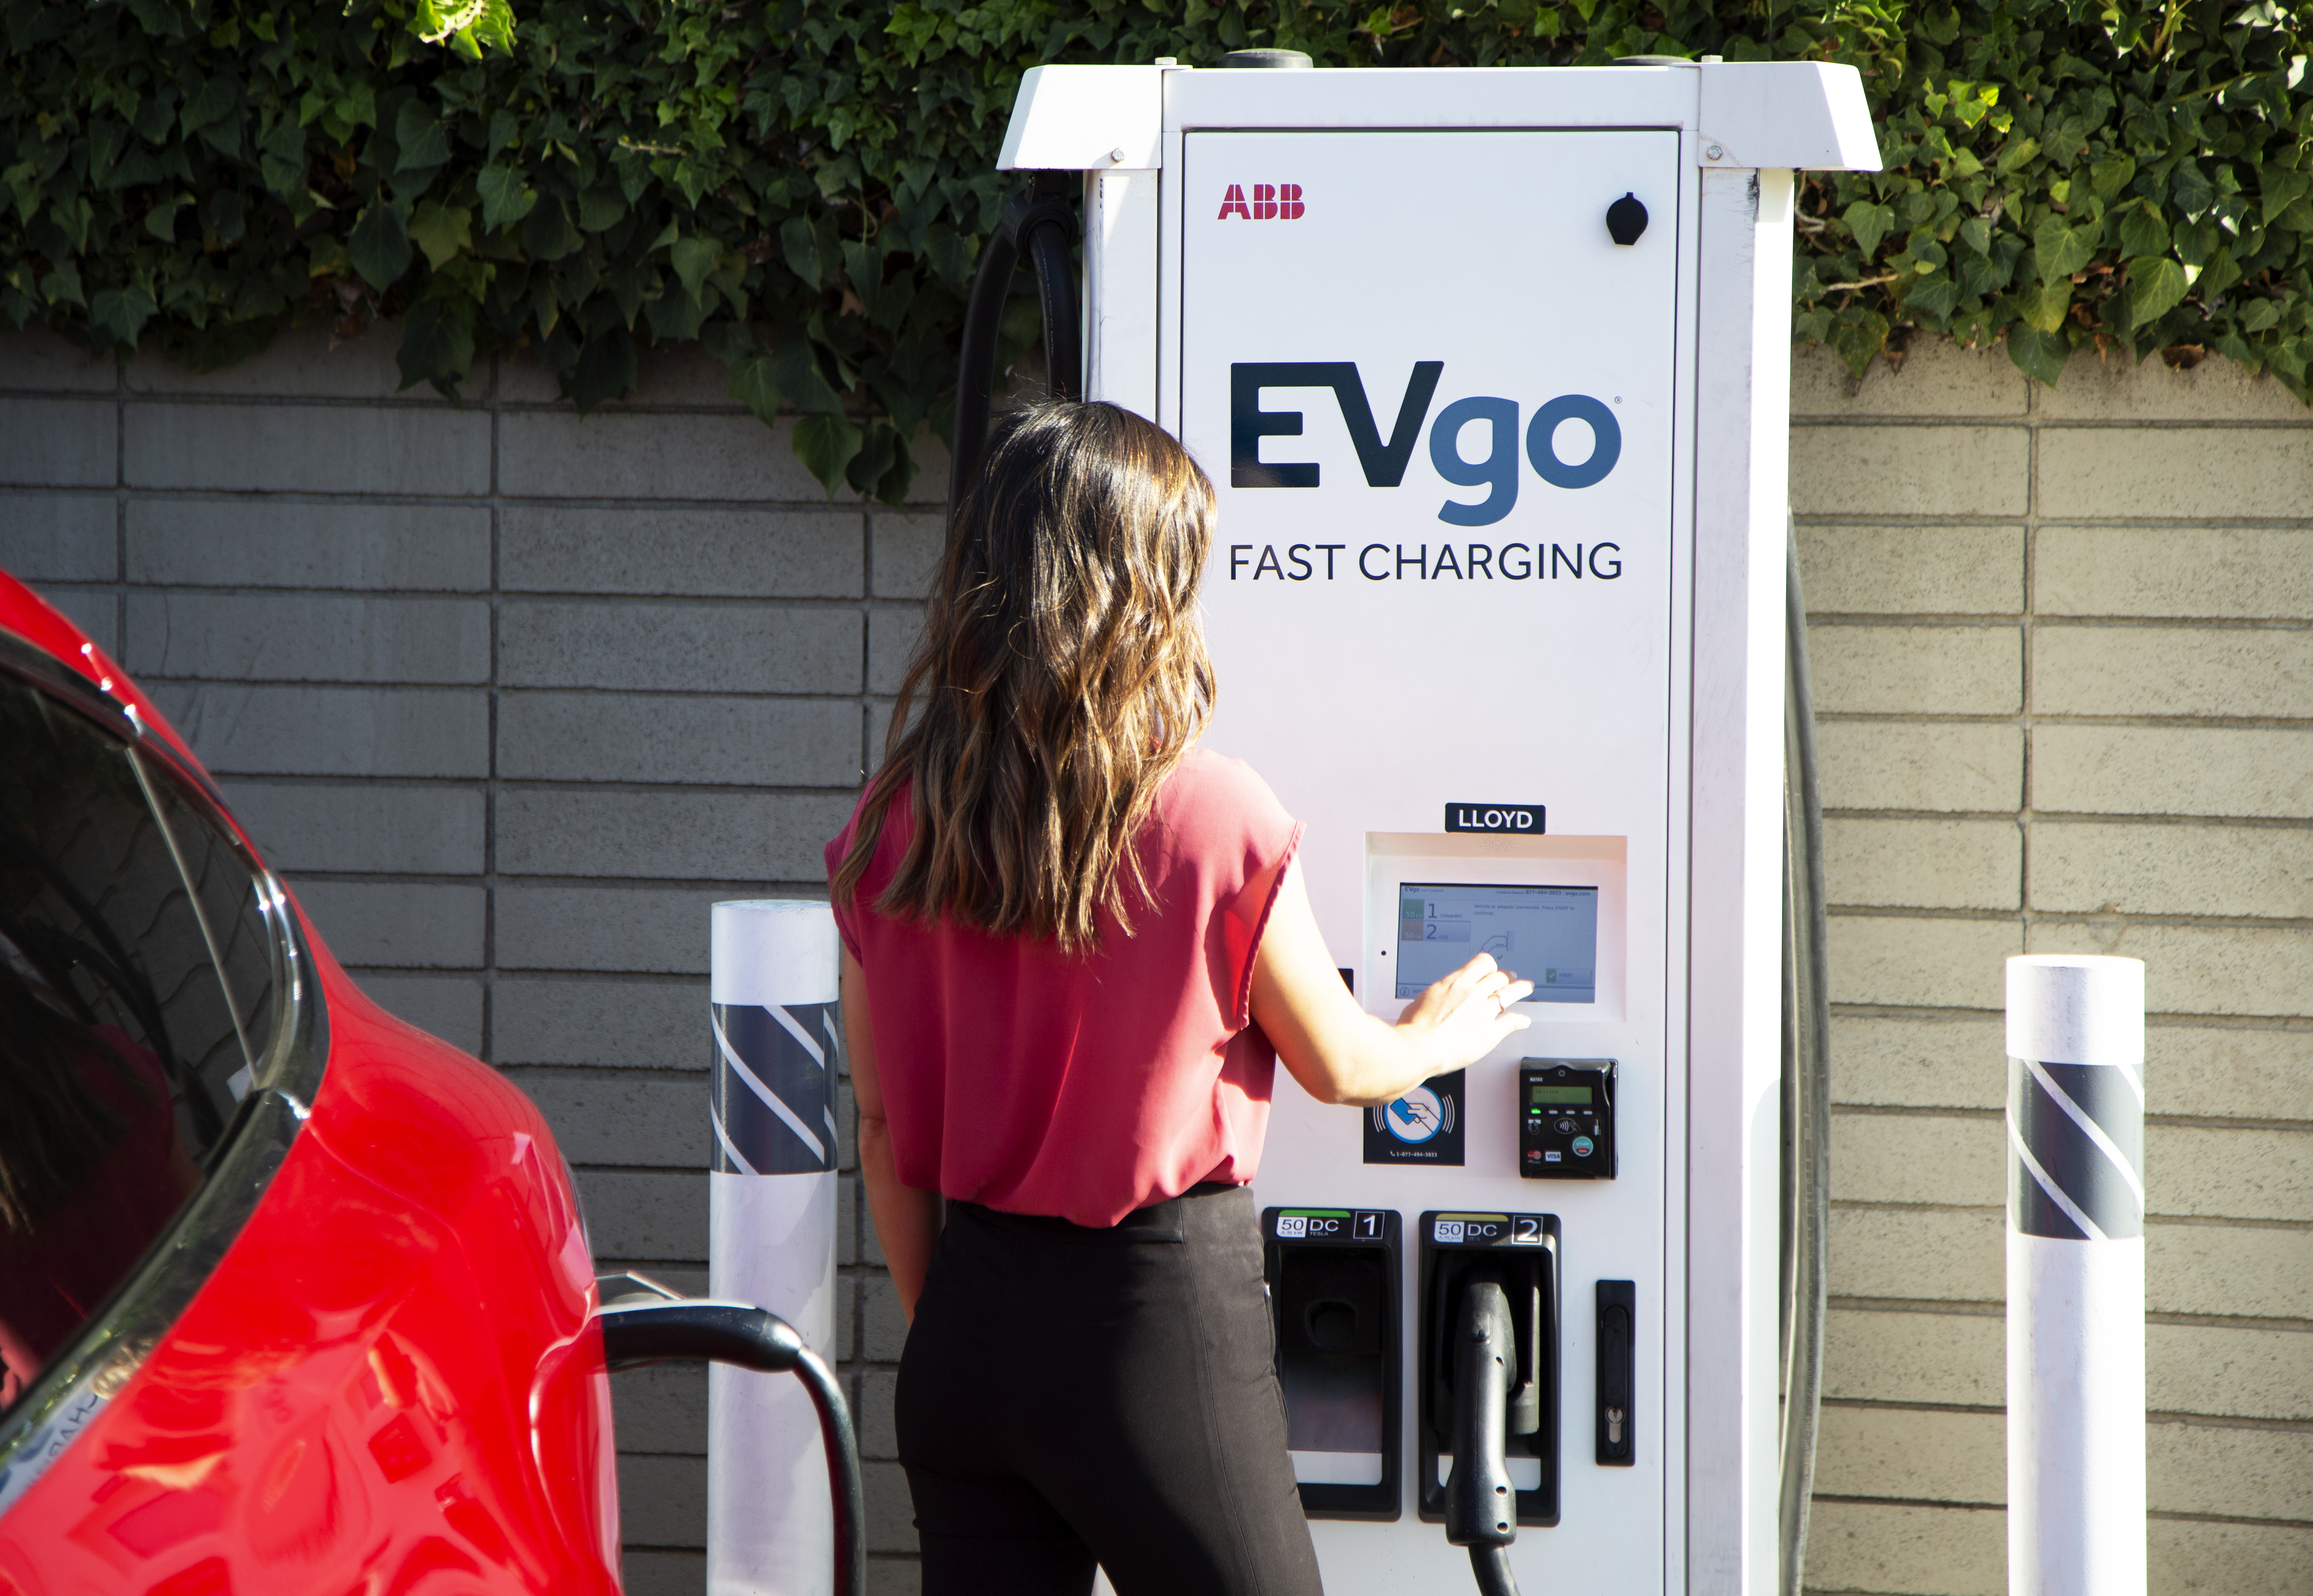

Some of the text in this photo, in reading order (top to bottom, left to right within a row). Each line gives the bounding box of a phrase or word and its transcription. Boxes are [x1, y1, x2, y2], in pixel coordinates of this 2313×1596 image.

[1217, 184, 1305, 220] ABB
[1231, 361, 1621, 527] EVgo
[1231, 542, 1622, 581] FAST CHARGING
[1459, 809, 1533, 829] LLOYD
[1428, 903, 1437, 919] 1
[1426, 924, 1437, 940] 2
[1282, 1215, 1376, 1236] 50 DC 1
[1438, 1220, 1538, 1242] 50 DC 2
